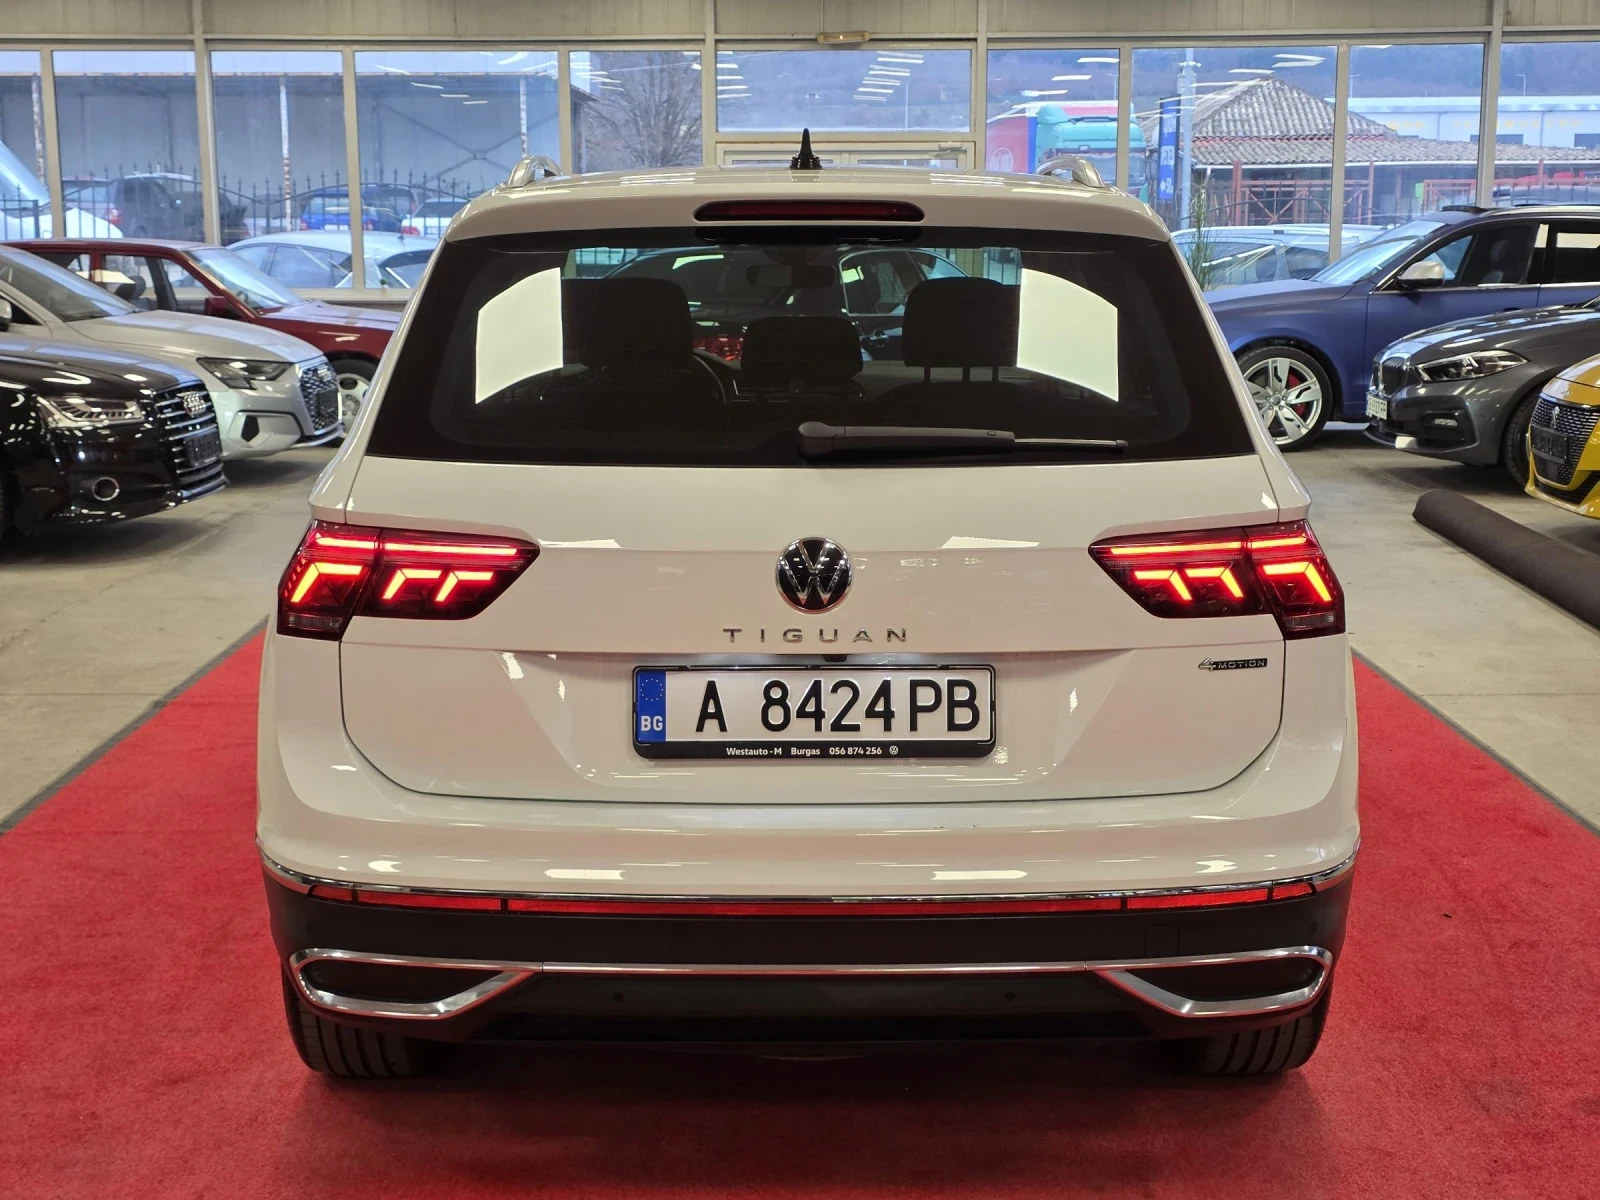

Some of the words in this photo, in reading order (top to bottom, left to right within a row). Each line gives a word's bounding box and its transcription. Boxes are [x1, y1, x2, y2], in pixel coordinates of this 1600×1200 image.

[722, 627, 908, 643] TIGUAN
[1198, 657, 1267, 671] 4MOTION
[695, 679, 728, 733] A
[760, 678, 896, 733] 8424
[908, 678, 981, 733] PB
[640, 715, 664, 732] BG
[790, 746, 821, 757] Burgas
[828, 746, 846, 755] 056
[847, 746, 864, 755] 874
[865, 746, 882, 755] 256
